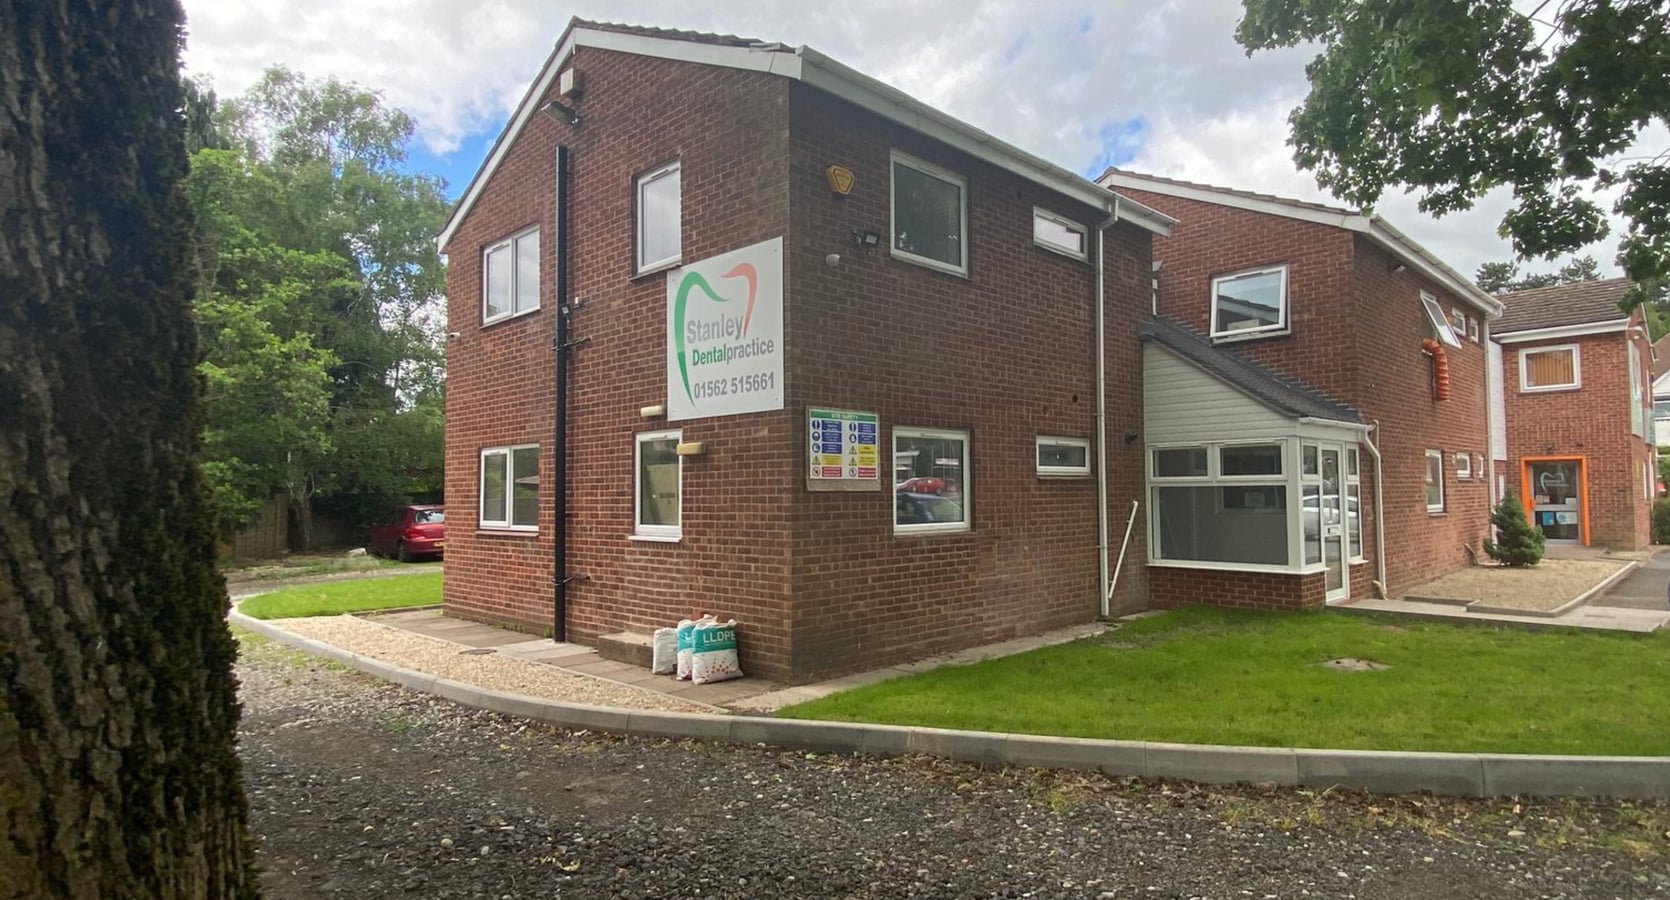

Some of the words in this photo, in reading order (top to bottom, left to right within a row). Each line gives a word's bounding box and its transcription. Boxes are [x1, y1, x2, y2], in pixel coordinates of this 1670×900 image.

[687, 313, 743, 344] Stanley
[694, 379, 727, 399] 01562
[731, 372, 775, 394] 515661
[703, 631, 736, 643] LLDPE
